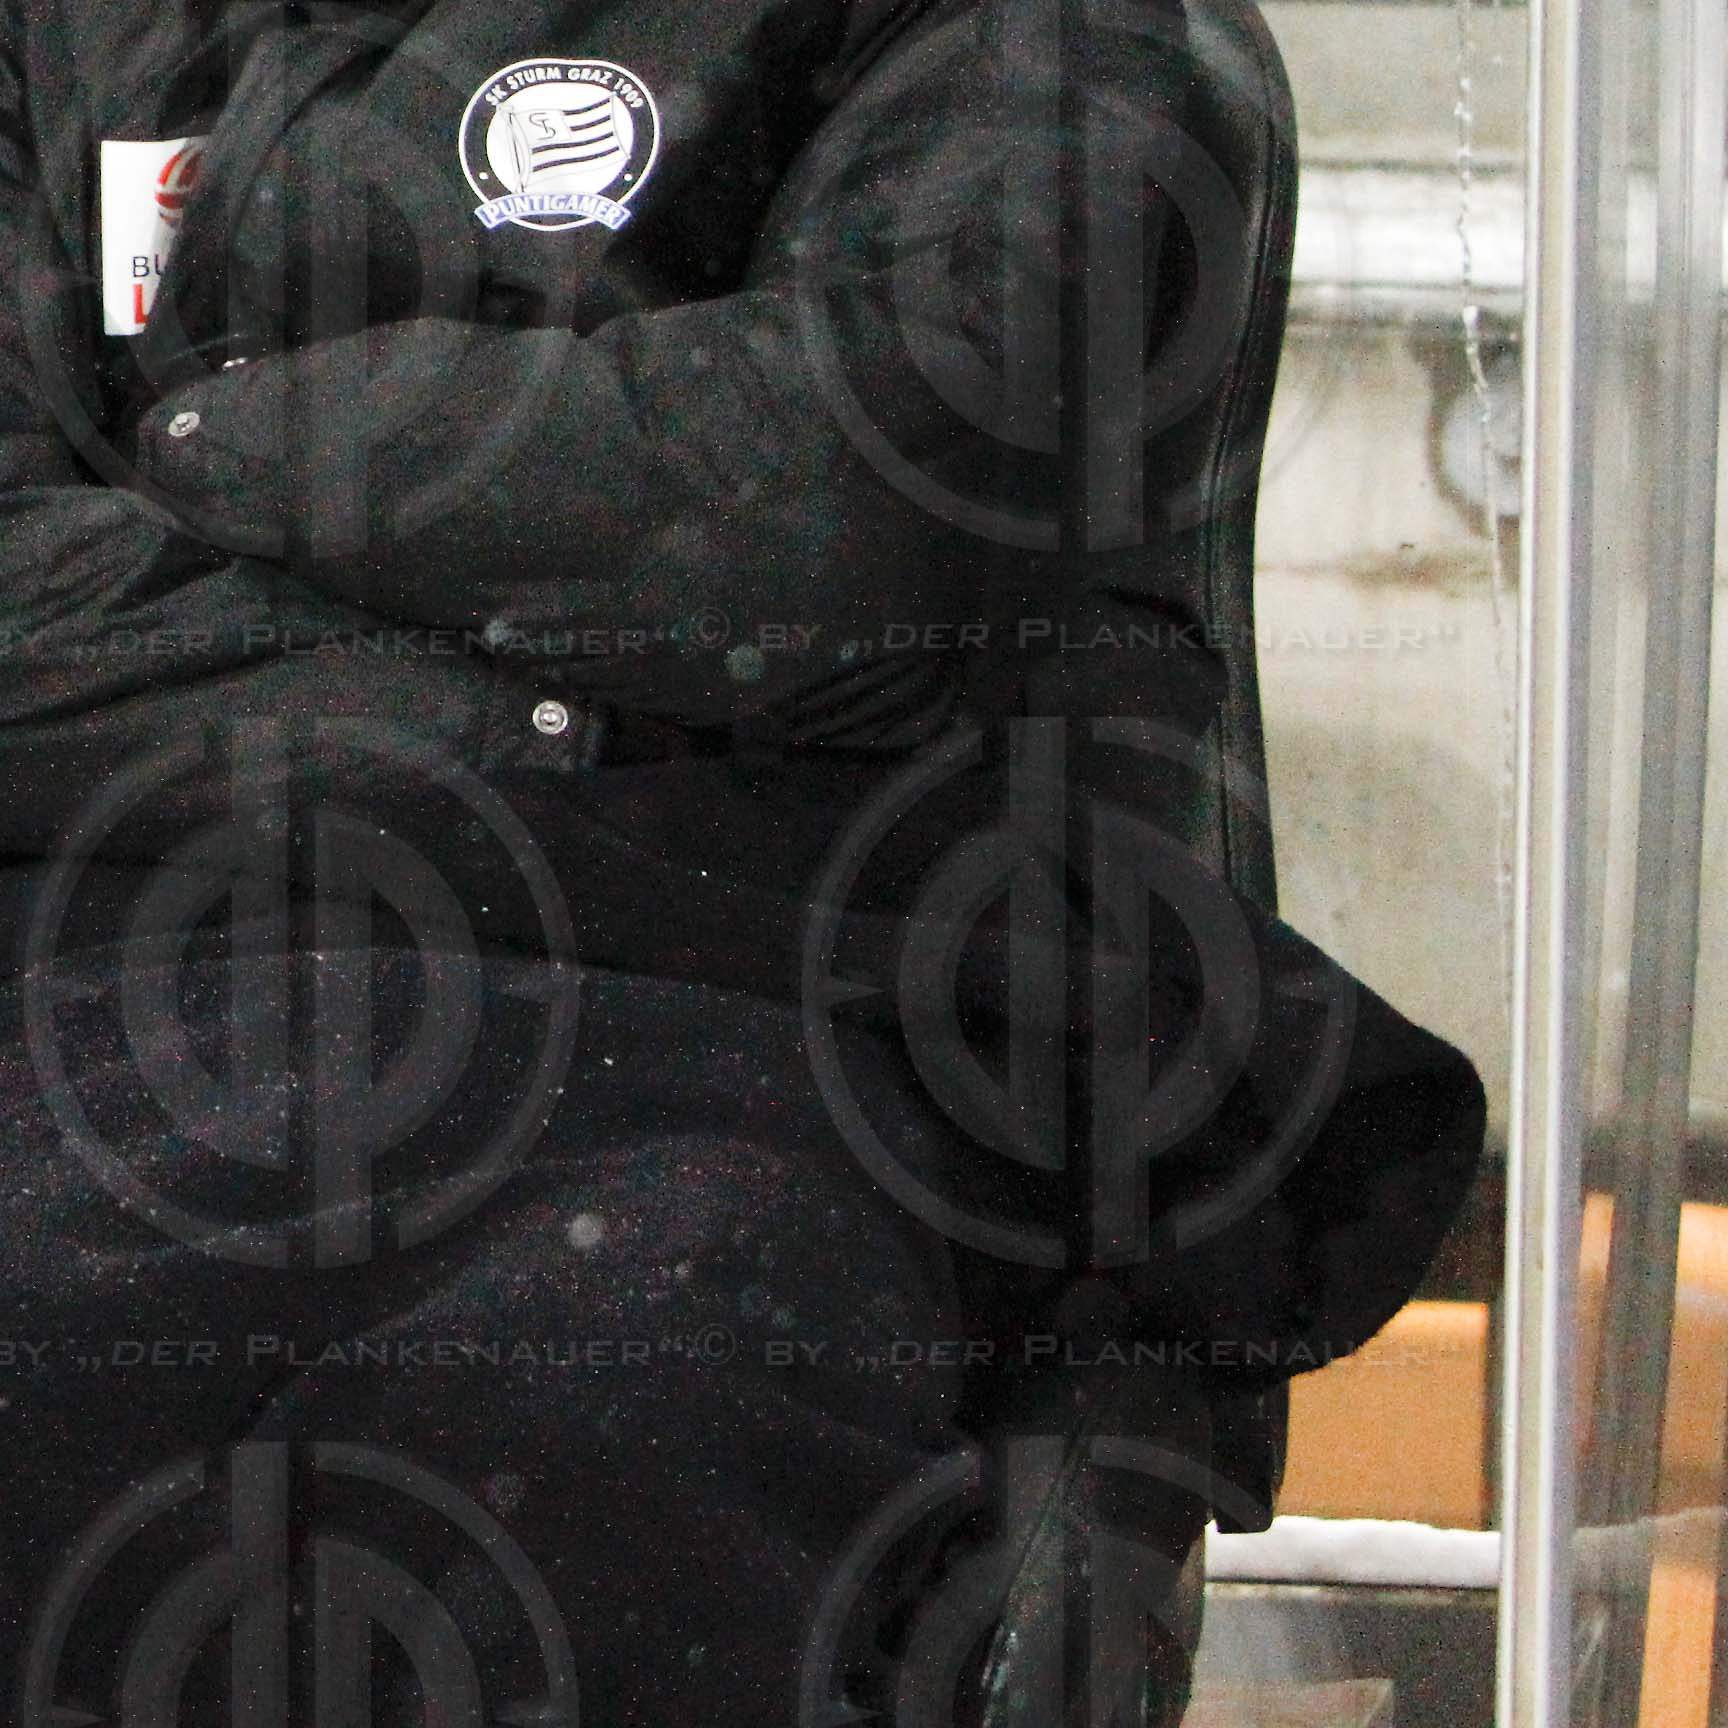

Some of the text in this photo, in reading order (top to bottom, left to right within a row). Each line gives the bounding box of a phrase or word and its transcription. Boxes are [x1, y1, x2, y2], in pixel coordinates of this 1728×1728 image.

[506, 66, 562, 90] STURM
[567, 67, 614, 83] GRAZ
[613, 76, 645, 109] 1909
[483, 194, 624, 225] PUNTIGAMER
